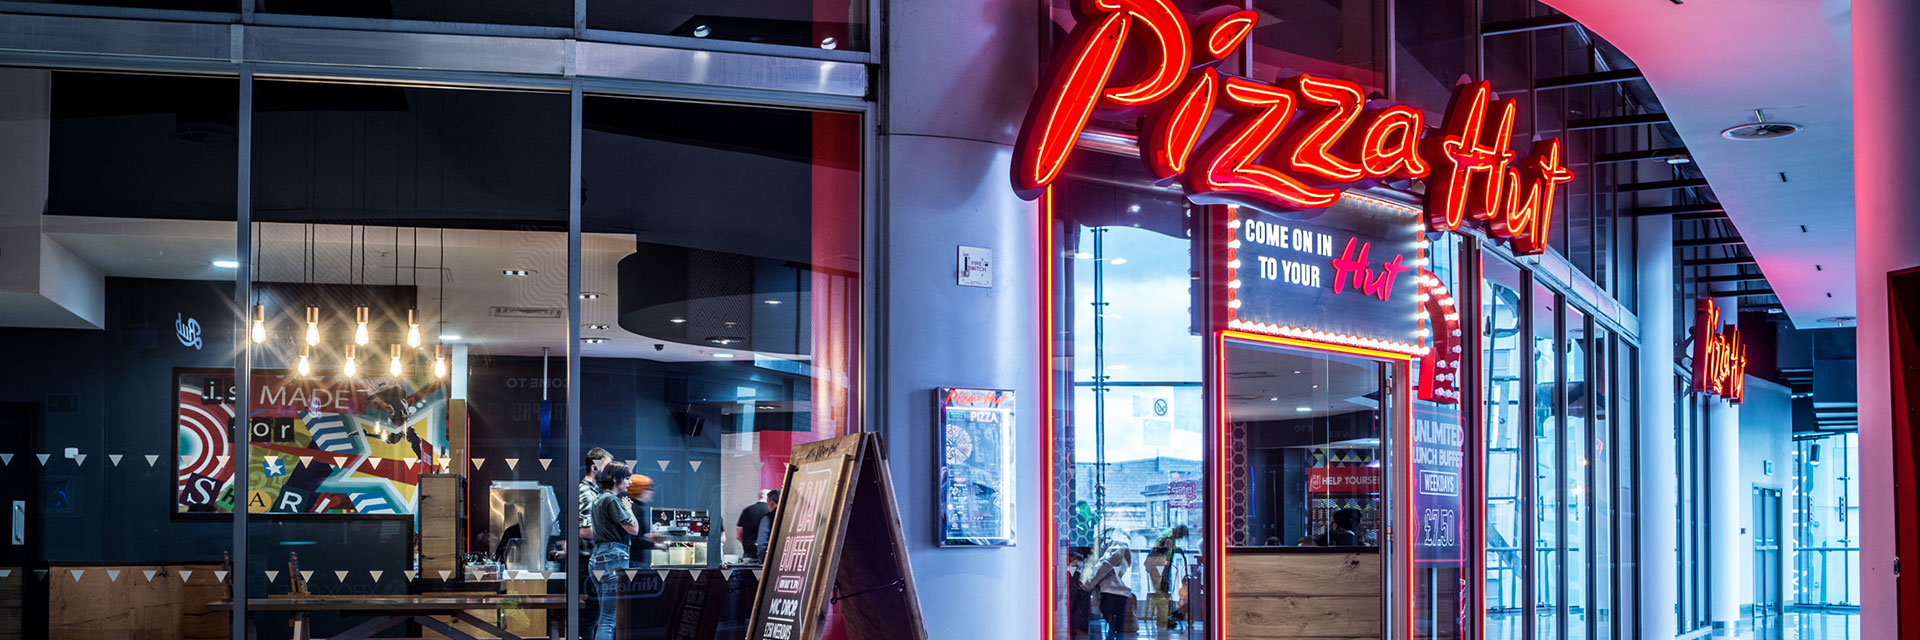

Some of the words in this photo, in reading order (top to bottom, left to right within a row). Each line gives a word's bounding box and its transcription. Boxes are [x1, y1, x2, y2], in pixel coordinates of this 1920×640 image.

[1024, 0, 1430, 207] Pizza
[1440, 79, 1576, 255] Hut
[1245, 219, 1289, 248] COME
[1292, 228, 1313, 253] ON
[1316, 233, 1333, 257] IN
[1258, 255, 1278, 280] TO
[1281, 260, 1321, 288] YOUR
[1331, 236, 1412, 301] Hut
[1703, 296, 1730, 395] Pizza
[1730, 323, 1748, 405] Hut
[259, 385, 350, 410] MADE
[944, 389, 981, 406] Pizza
[983, 391, 1008, 406] Hut
[970, 411, 999, 423] PIZZA
[1412, 418, 1465, 447] UNLIMITED
[1412, 446, 1438, 465] LUNCH
[1439, 449, 1464, 468] BUFFET
[1321, 476, 1342, 486] HELP
[1424, 473, 1454, 493] WEEKDAYS
[788, 482, 805, 533] 7
[796, 480, 828, 533] DAY
[1424, 508, 1455, 547] £7.50
[779, 535, 815, 571] BUFFET
[768, 598, 782, 615] MIC
